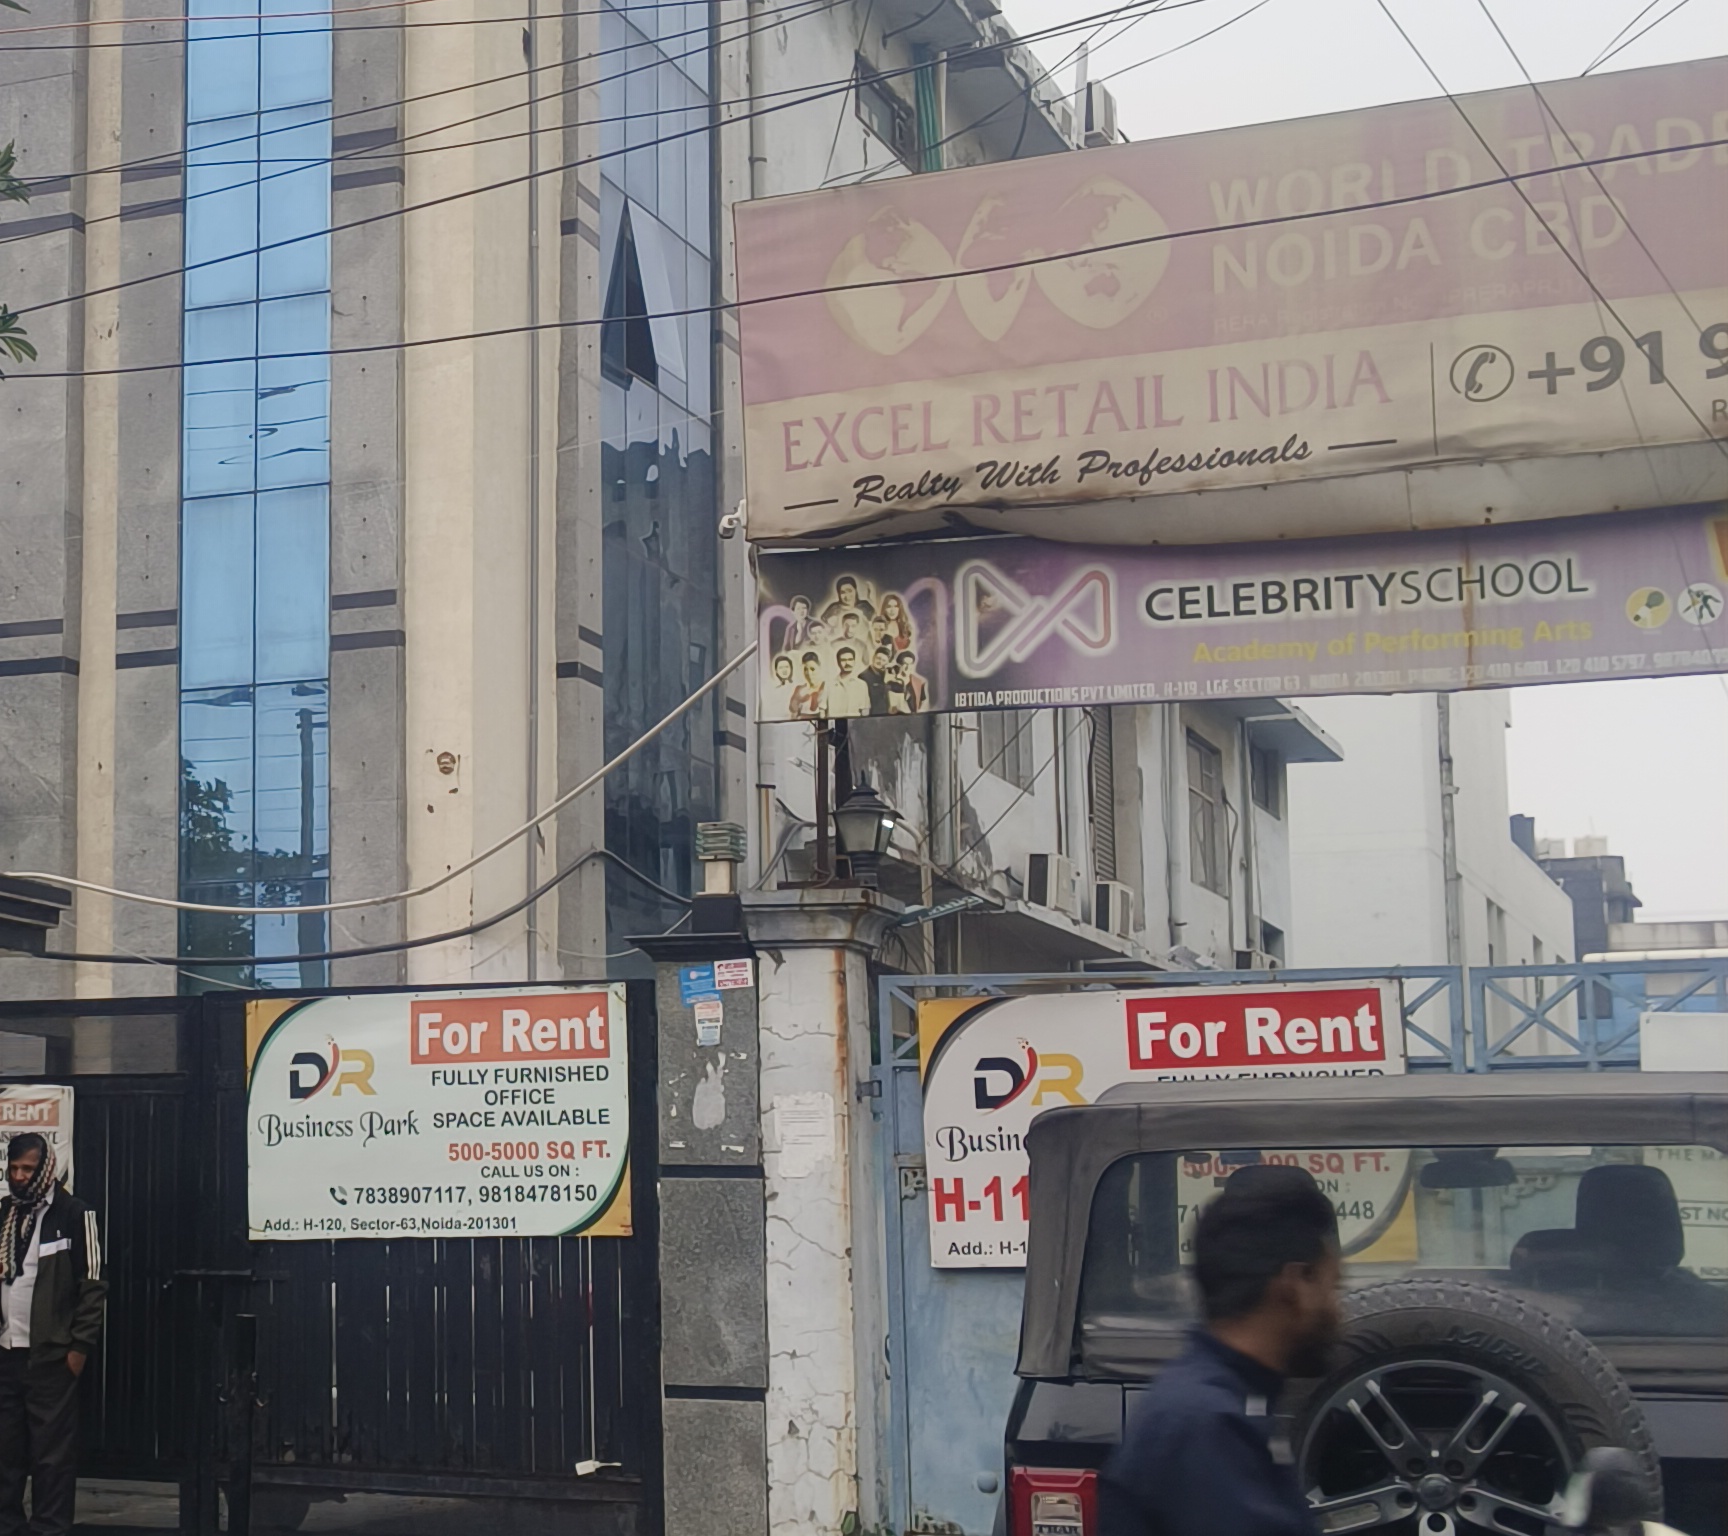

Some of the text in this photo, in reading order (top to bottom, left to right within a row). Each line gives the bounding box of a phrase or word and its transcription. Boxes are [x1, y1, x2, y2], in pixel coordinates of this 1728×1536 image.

[1209, 148, 1471, 224] WORLD
[1212, 195, 1628, 295] NOIDA CBD
[1527, 330, 1666, 396] +91
[782, 348, 1393, 473] EXCEL RETAIL INDIA
[853, 432, 1313, 509] Realty With Professionals
[1144, 557, 1590, 623] CELEBRITYSCHOOL
[1192, 619, 1593, 666] Academy of Performing Arts
[954, 689, 994, 707] IBTIDA
[1080, 684, 1104, 702] PVT
[418, 1005, 606, 1056] For Rent
[1137, 1005, 1379, 1061] For Rent
[431, 1065, 610, 1087] FULLY FURNISHED
[484, 1088, 556, 1106] OFFICE
[2, 1102, 53, 1122] RENT
[433, 1108, 611, 1129] SPACE AVAILABLE
[258, 1110, 421, 1148] Business Park
[448, 1139, 611, 1162] 500-5000 SQ FT.
[480, 1165, 520, 1179] CALL
[524, 1164, 544, 1178] US
[548, 1164, 571, 1178] ON
[1308, 1153, 1345, 1175] SQ
[353, 1184, 598, 1206] 7838907117, 9818478150
[263, 1218, 300, 1232] Add.:
[303, 1218, 347, 1233] H-120,
[948, 1241, 994, 1256] Add.:
